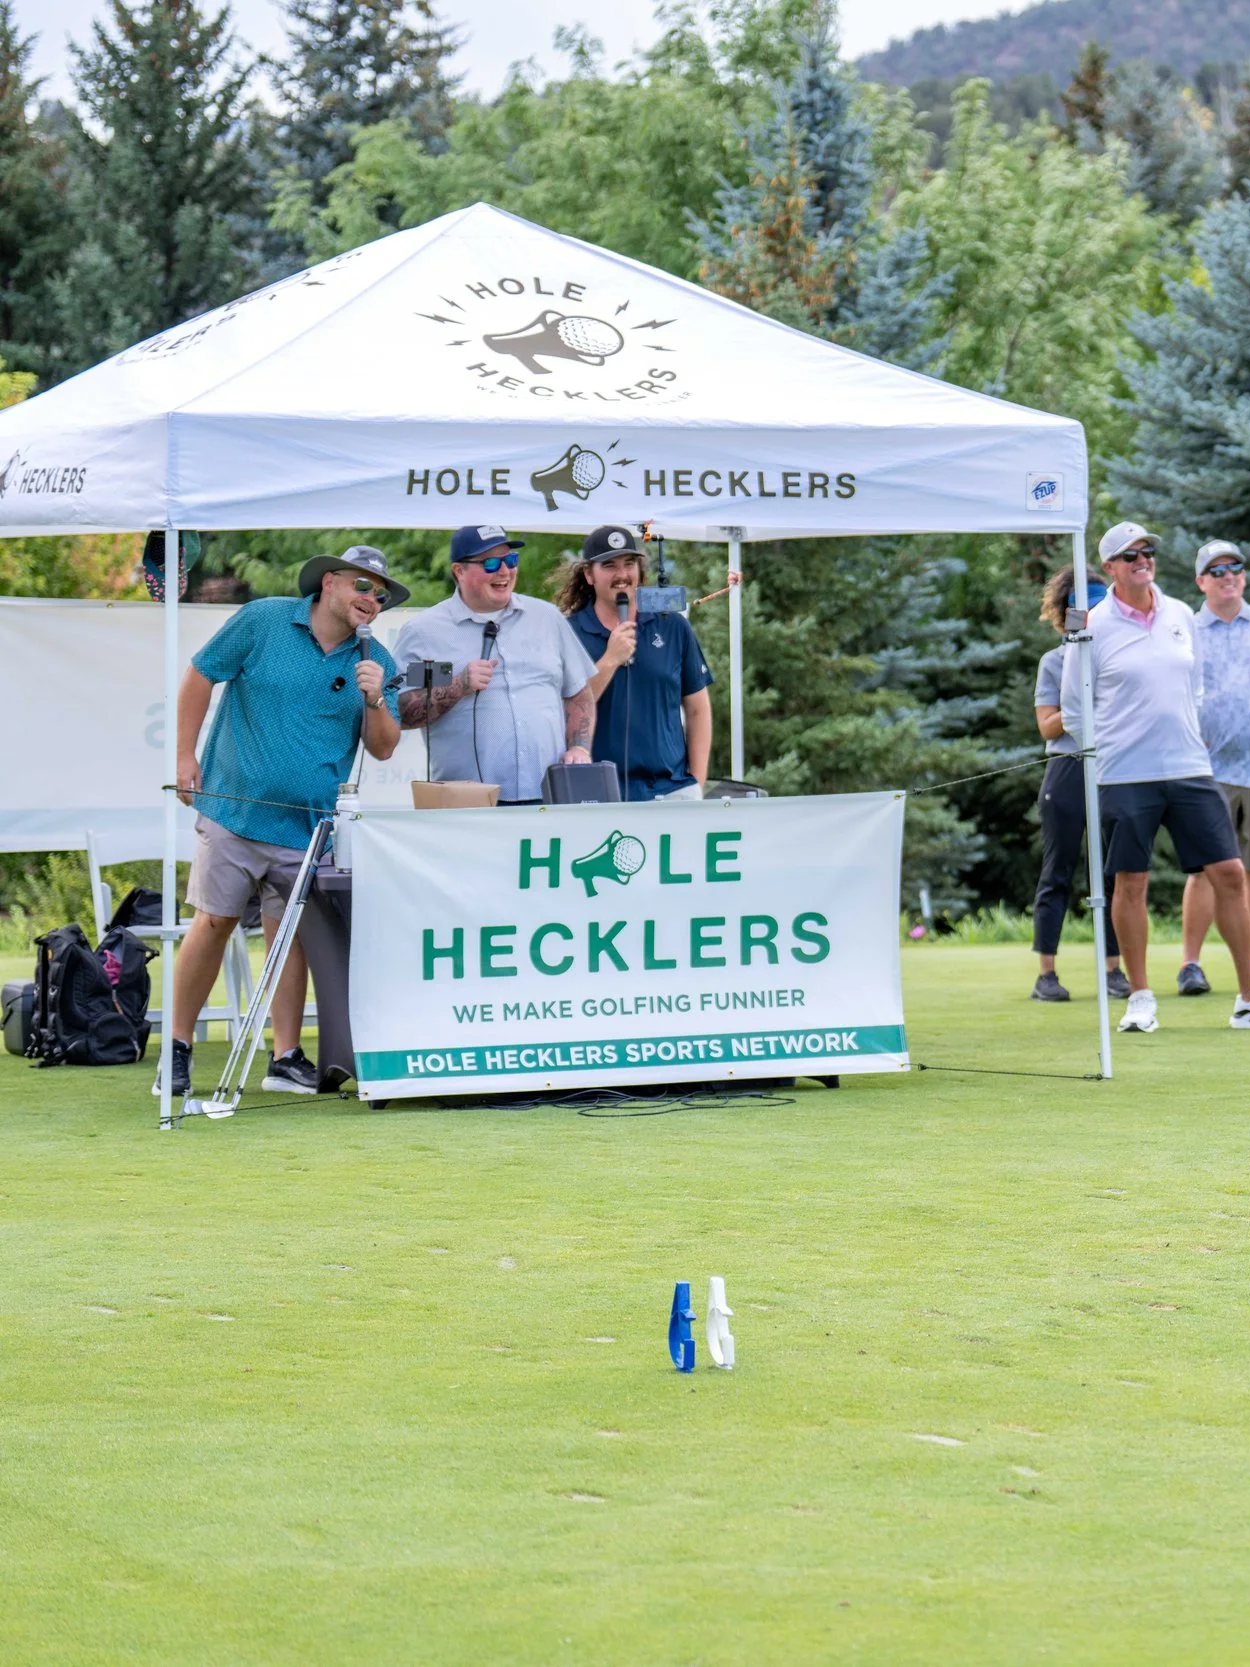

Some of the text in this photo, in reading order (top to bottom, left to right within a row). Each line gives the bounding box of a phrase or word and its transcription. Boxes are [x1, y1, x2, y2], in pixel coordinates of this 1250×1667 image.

[465, 276, 587, 302] HOLE
[465, 362, 677, 401] HECKLERS
[19, 467, 87, 494] HECKLERS
[406, 468, 857, 499] HOLE HECKLERS
[421, 911, 831, 981] HECKLERS
[452, 988, 806, 1024] WE MAKE GOLFING FUNNIER
[406, 1031, 860, 1074] HOLE HECKLERS SPORTS NETWORK
